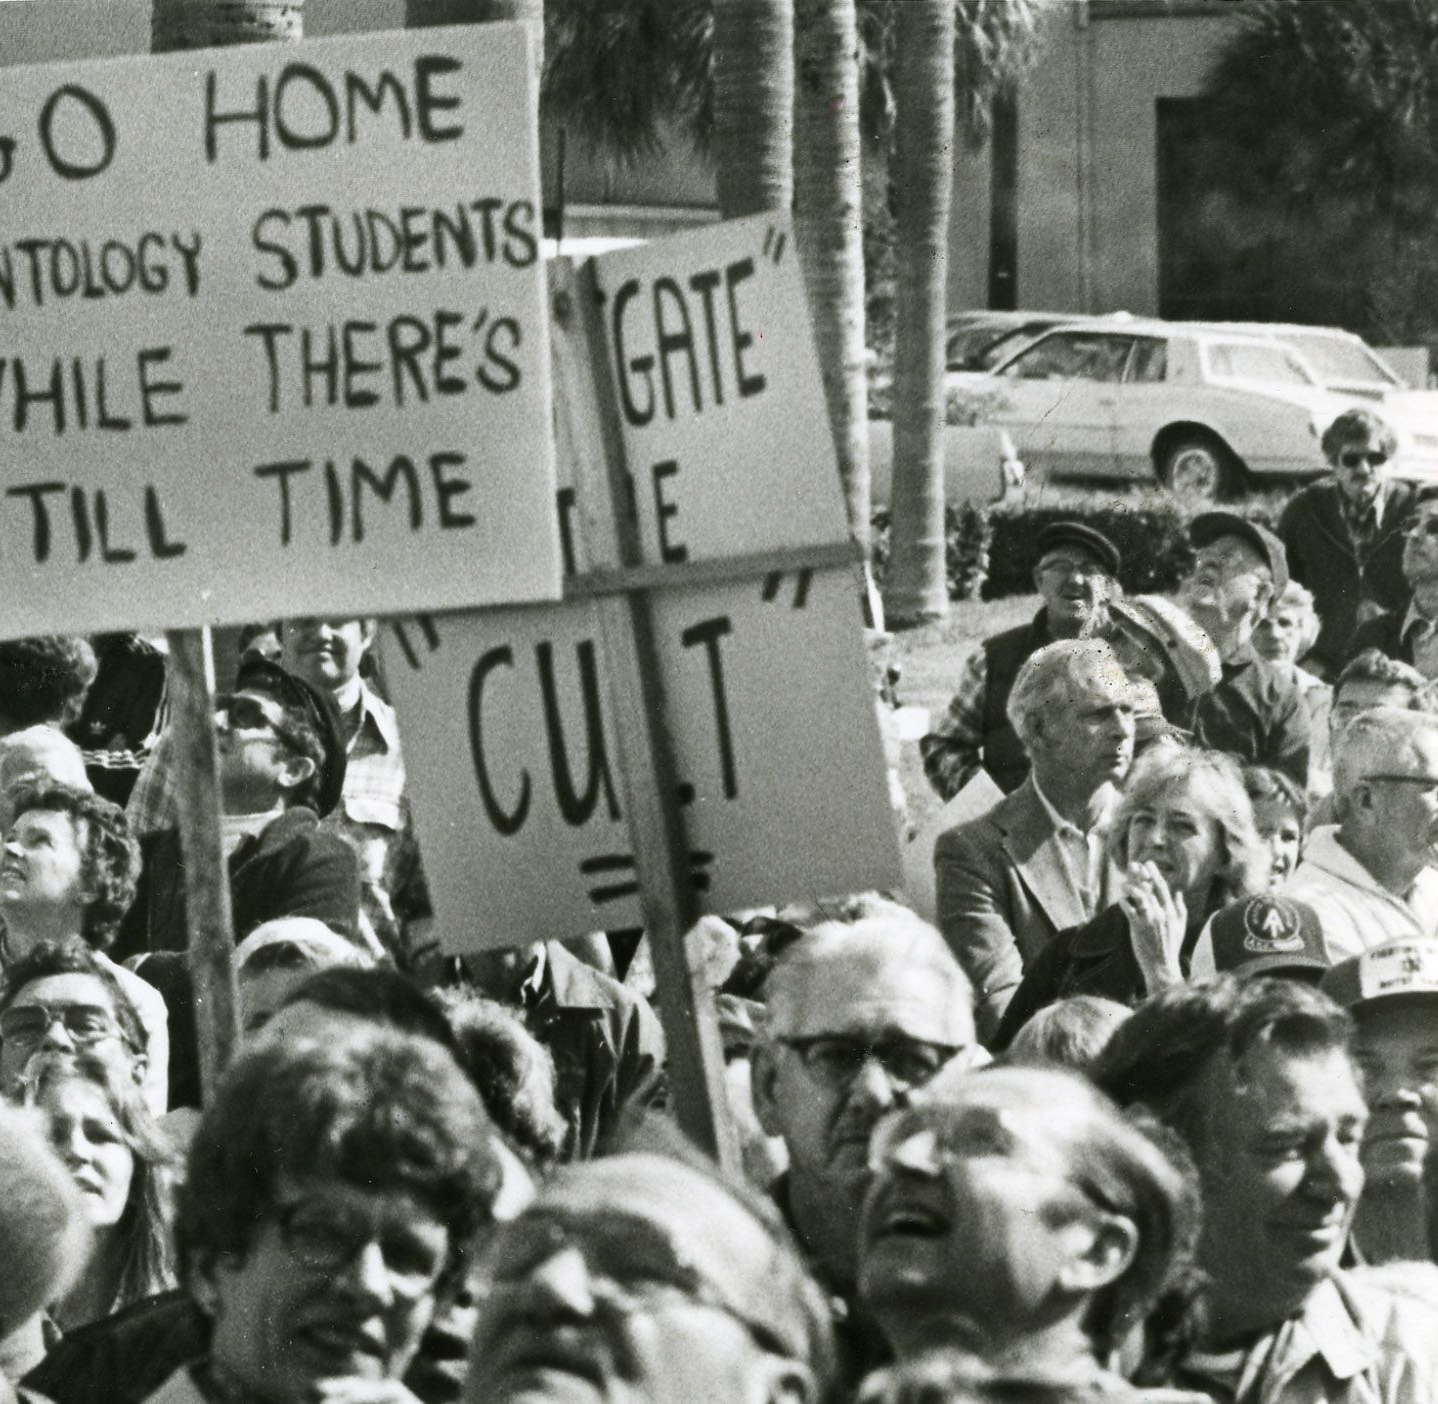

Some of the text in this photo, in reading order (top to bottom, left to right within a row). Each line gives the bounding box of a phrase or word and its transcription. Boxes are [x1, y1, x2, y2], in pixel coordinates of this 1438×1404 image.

[205, 55, 464, 164] HOME
[253, 198, 538, 290] STUDENTS
[244, 299, 522, 413] THERE'S
[254, 452, 476, 547] TIME
[391, 568, 814, 837] "CUT"
